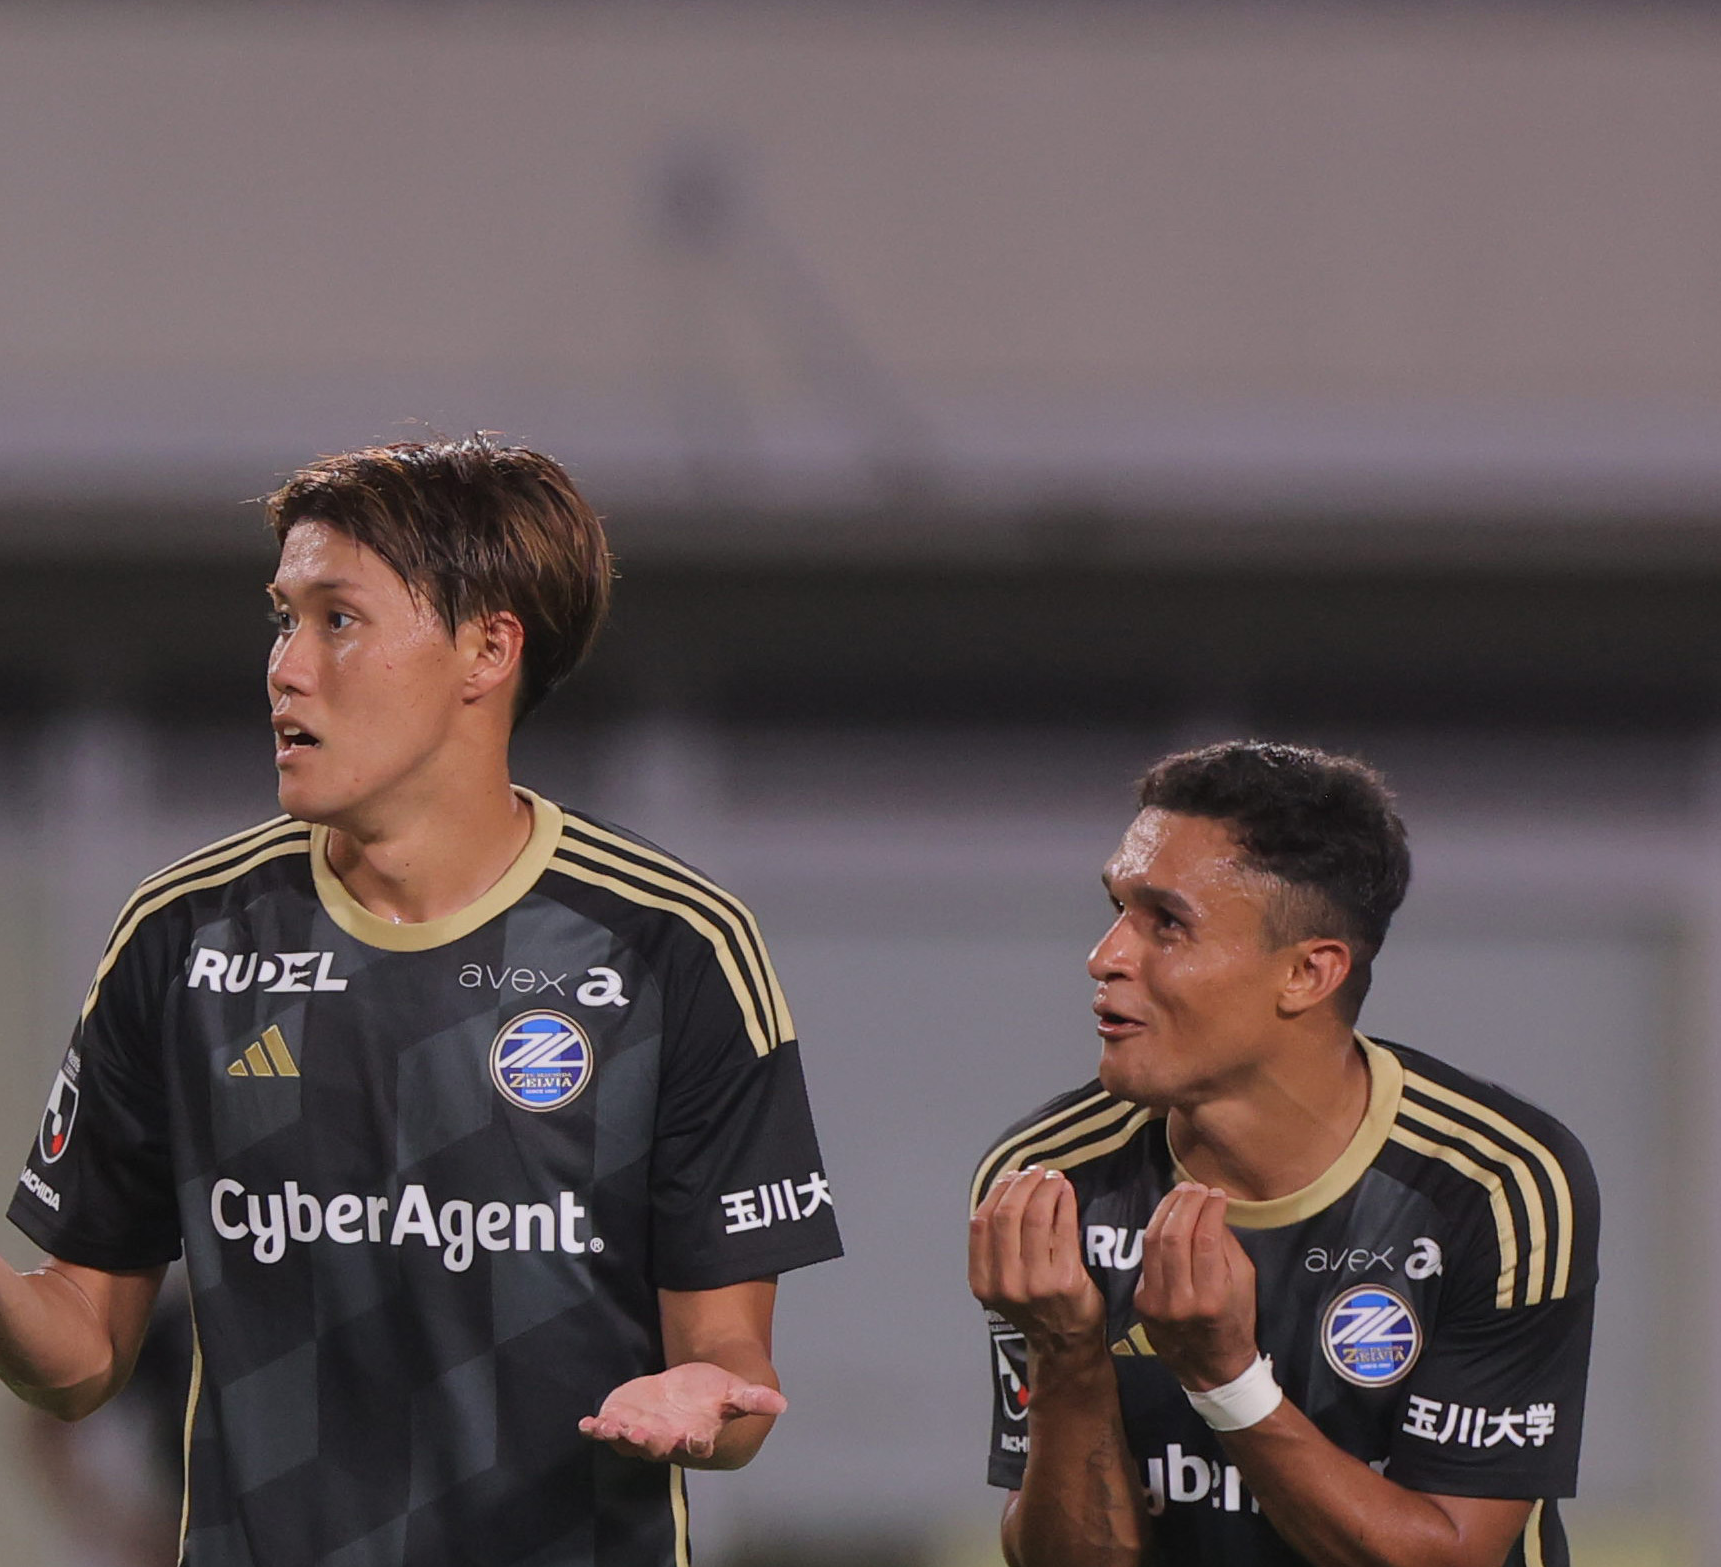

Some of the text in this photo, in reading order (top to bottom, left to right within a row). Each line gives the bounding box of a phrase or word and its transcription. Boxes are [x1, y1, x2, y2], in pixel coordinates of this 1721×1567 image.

[187, 947, 348, 993] RUDEL
[458, 963, 568, 997] avex
[20, 1166, 61, 1212] ACHIDA
[720, 1171, 833, 1235] 玉川大
[1305, 1246, 1395, 1273] avex
[1402, 1394, 1556, 1448] 玉川大学
